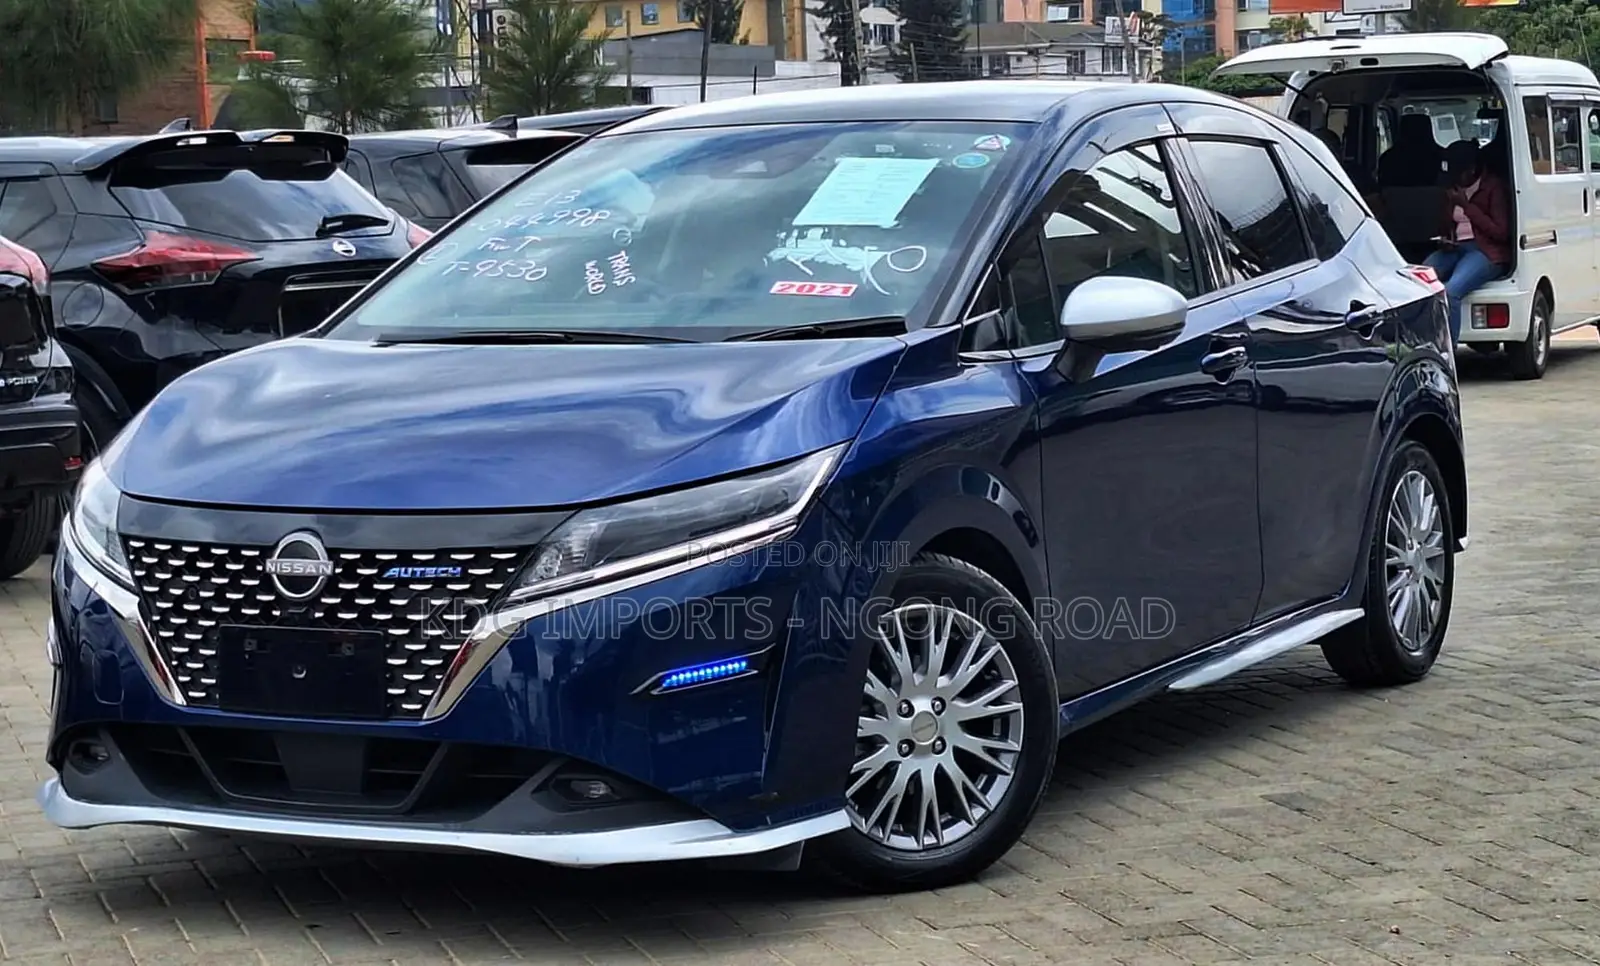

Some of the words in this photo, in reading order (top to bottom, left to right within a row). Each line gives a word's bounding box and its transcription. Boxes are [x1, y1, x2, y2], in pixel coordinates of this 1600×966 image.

[776, 283, 854, 295] 2021
[266, 559, 333, 575] NISSAN
[382, 567, 461, 578] AUTECH
